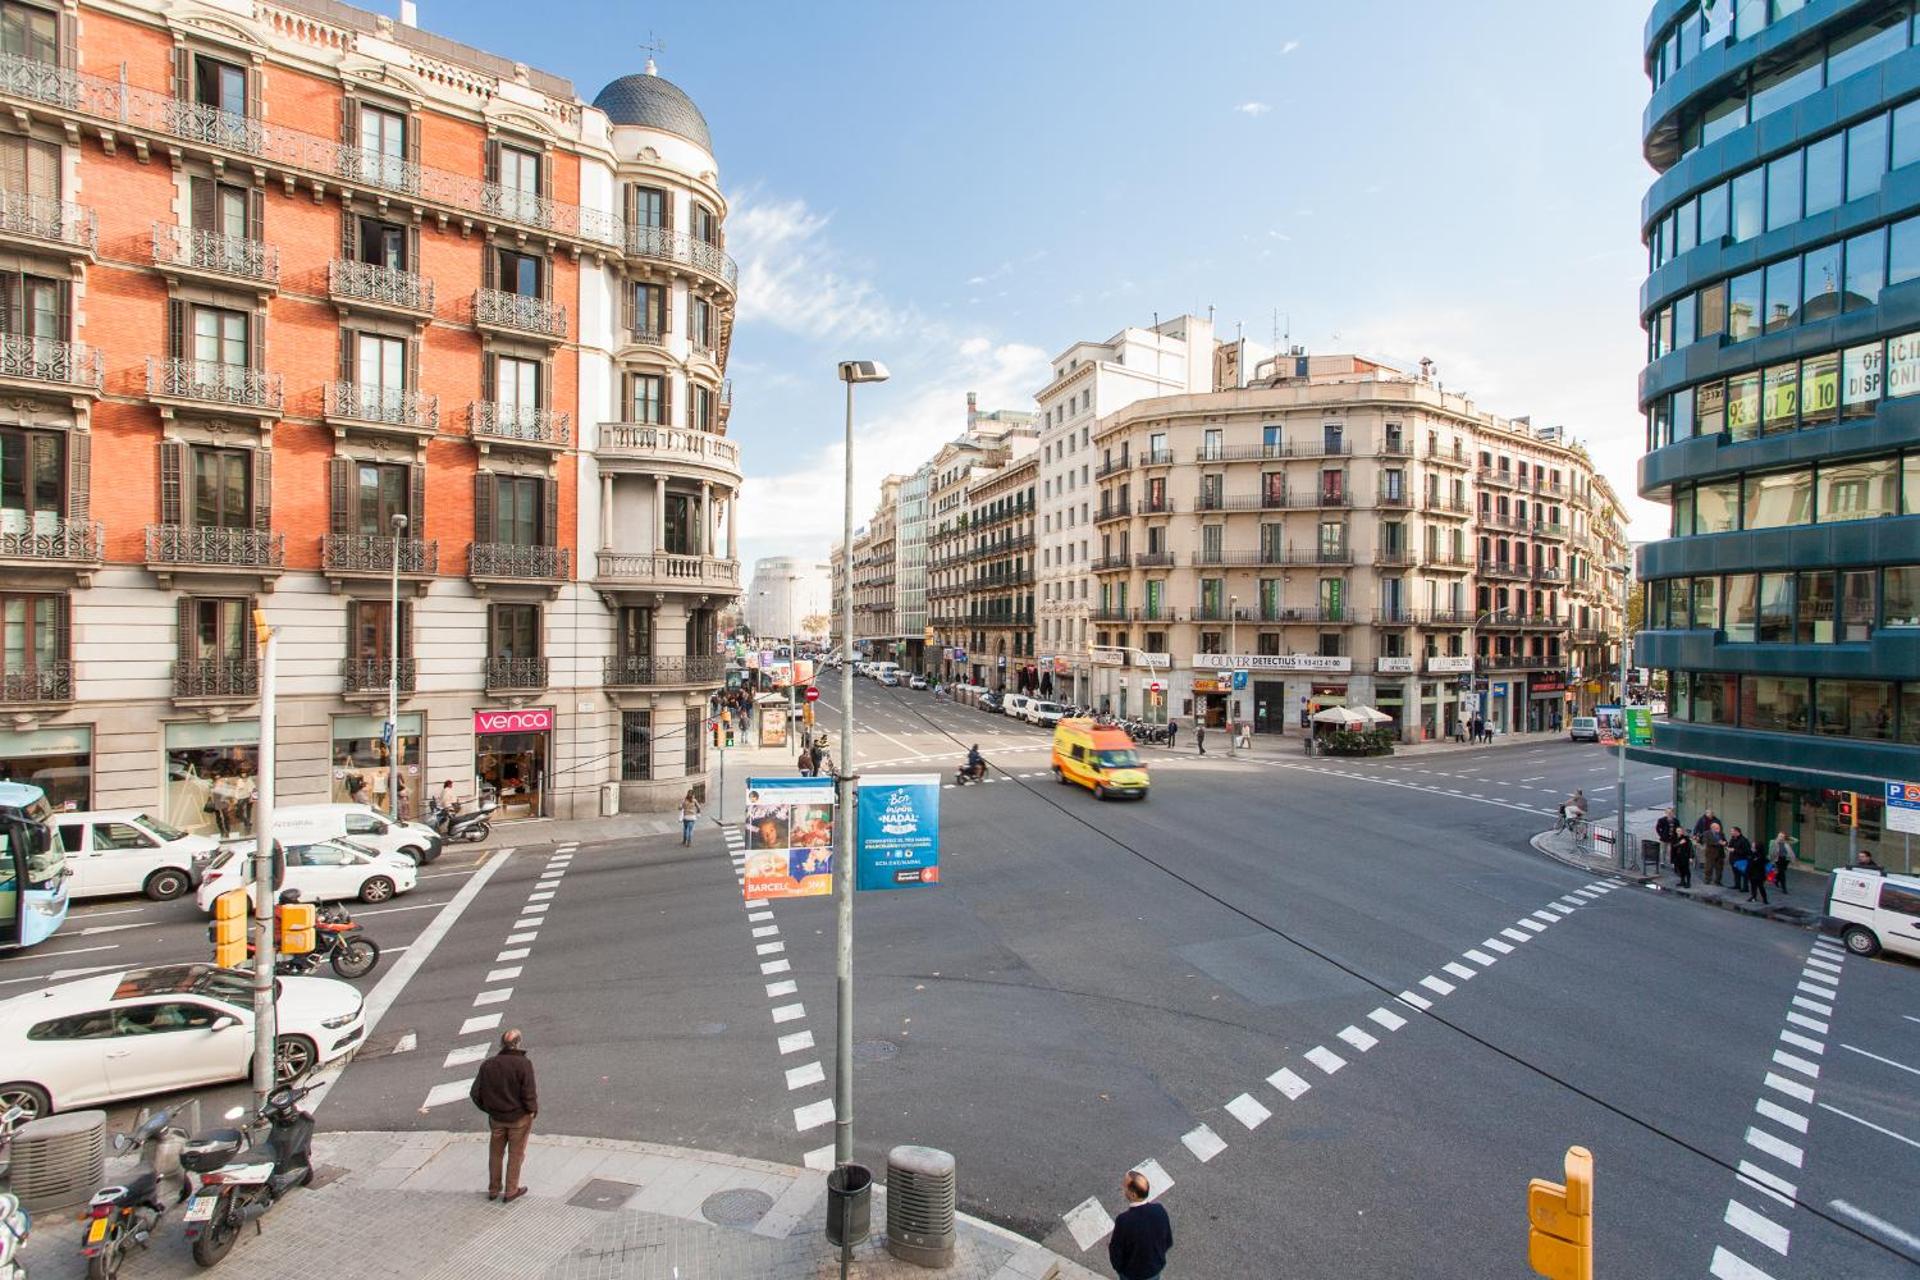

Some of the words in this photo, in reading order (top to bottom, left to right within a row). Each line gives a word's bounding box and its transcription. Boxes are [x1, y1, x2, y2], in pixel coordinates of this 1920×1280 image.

[1252, 656, 1297, 666] DETECTIUS
[479, 713, 548, 730] venca
[1890, 785, 1901, 796] P
[882, 814, 918, 823] NADAL
